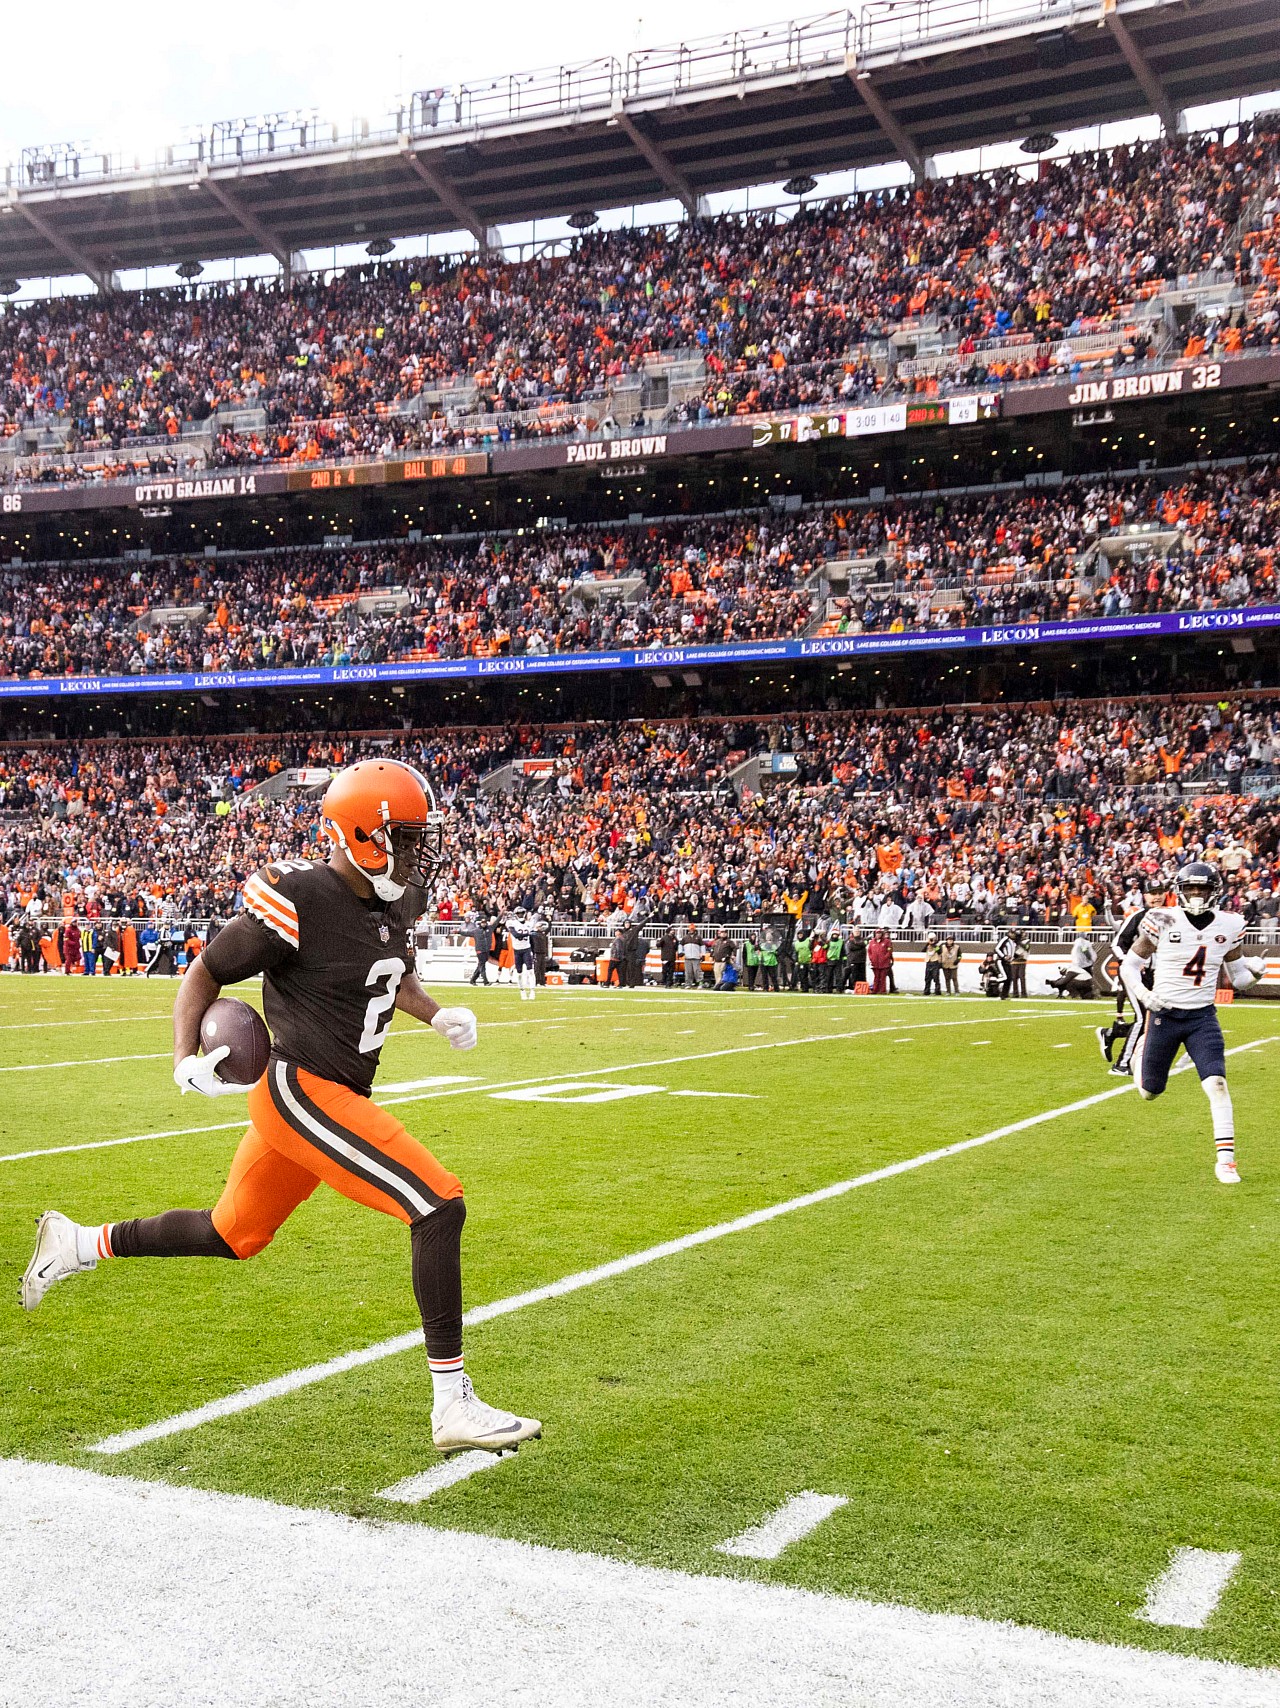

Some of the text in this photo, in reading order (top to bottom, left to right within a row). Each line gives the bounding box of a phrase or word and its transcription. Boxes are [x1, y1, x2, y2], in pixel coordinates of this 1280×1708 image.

[1068, 364, 1221, 405] JIM BROWN 32
[856, 412, 900, 428] 3:09 40
[908, 408, 926, 422] 2ND
[958, 408, 970, 420] 49
[984, 406, 991, 418] 4
[780, 424, 791, 440] 17
[827, 418, 839, 434] 10
[566, 436, 666, 463] PAUL BROWN
[404, 462, 426, 478] BALL
[432, 460, 446, 476] ON
[311, 470, 354, 488] 2ND & 4
[135, 476, 256, 501] OTTO GRAHAM 14
[3, 494, 22, 512] 86
[1179, 612, 1244, 629] LECOM
[981, 628, 1040, 644] LECOM
[1068, 627, 1090, 635] COLLEGE
[1135, 622, 1161, 630] MEDICINE
[801, 640, 854, 654] LECOM
[634, 651, 684, 664] LECOM
[333, 668, 377, 680] LECOM
[478, 660, 524, 672] LECOM
[60, 681, 100, 691] LECOM
[194, 675, 236, 686] LECOM
[1182, 946, 1208, 986] 4
[856, 984, 868, 992] 20
[1219, 991, 1230, 1001] 10
[359, 957, 406, 1054] 2
